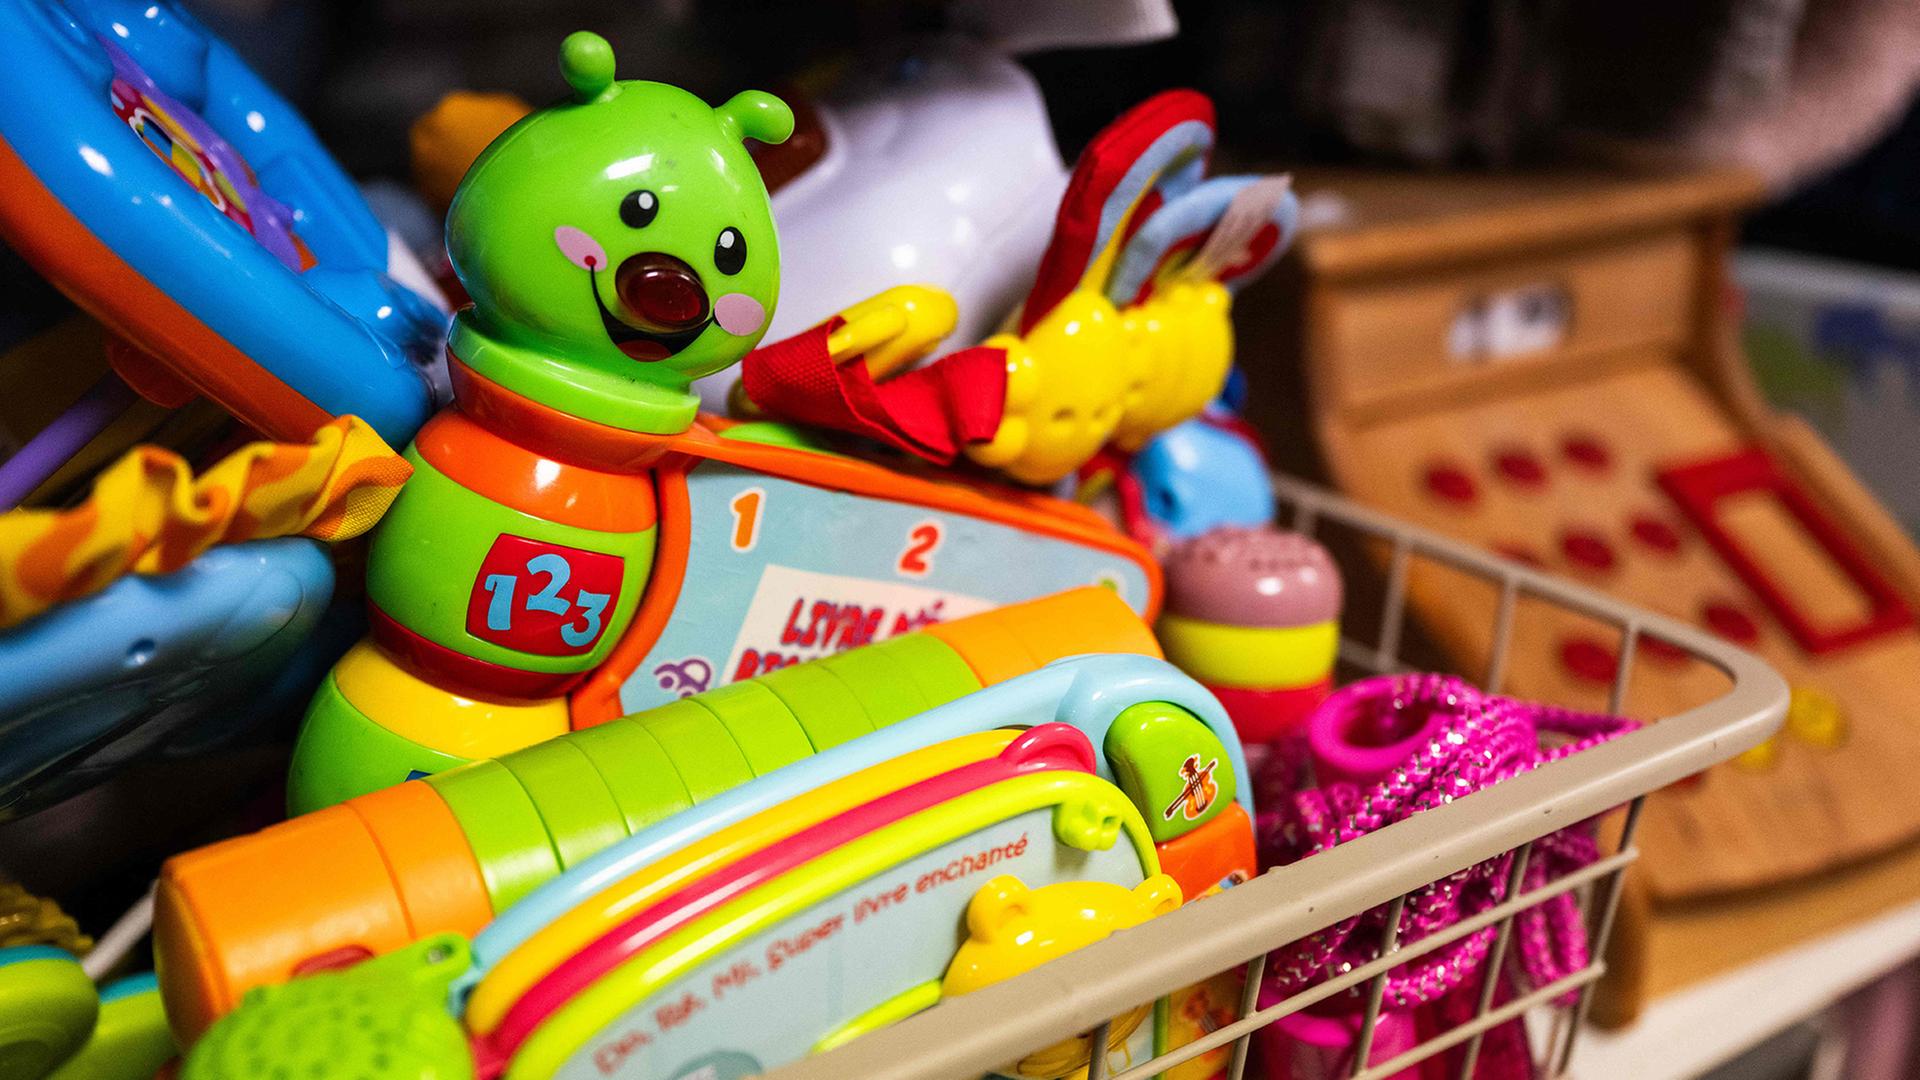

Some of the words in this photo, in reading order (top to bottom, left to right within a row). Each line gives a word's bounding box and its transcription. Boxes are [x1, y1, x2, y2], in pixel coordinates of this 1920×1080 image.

[731, 491, 762, 550] 1
[898, 524, 940, 573] 2
[853, 884, 908, 923] livre
[915, 834, 1029, 894] enchanté
